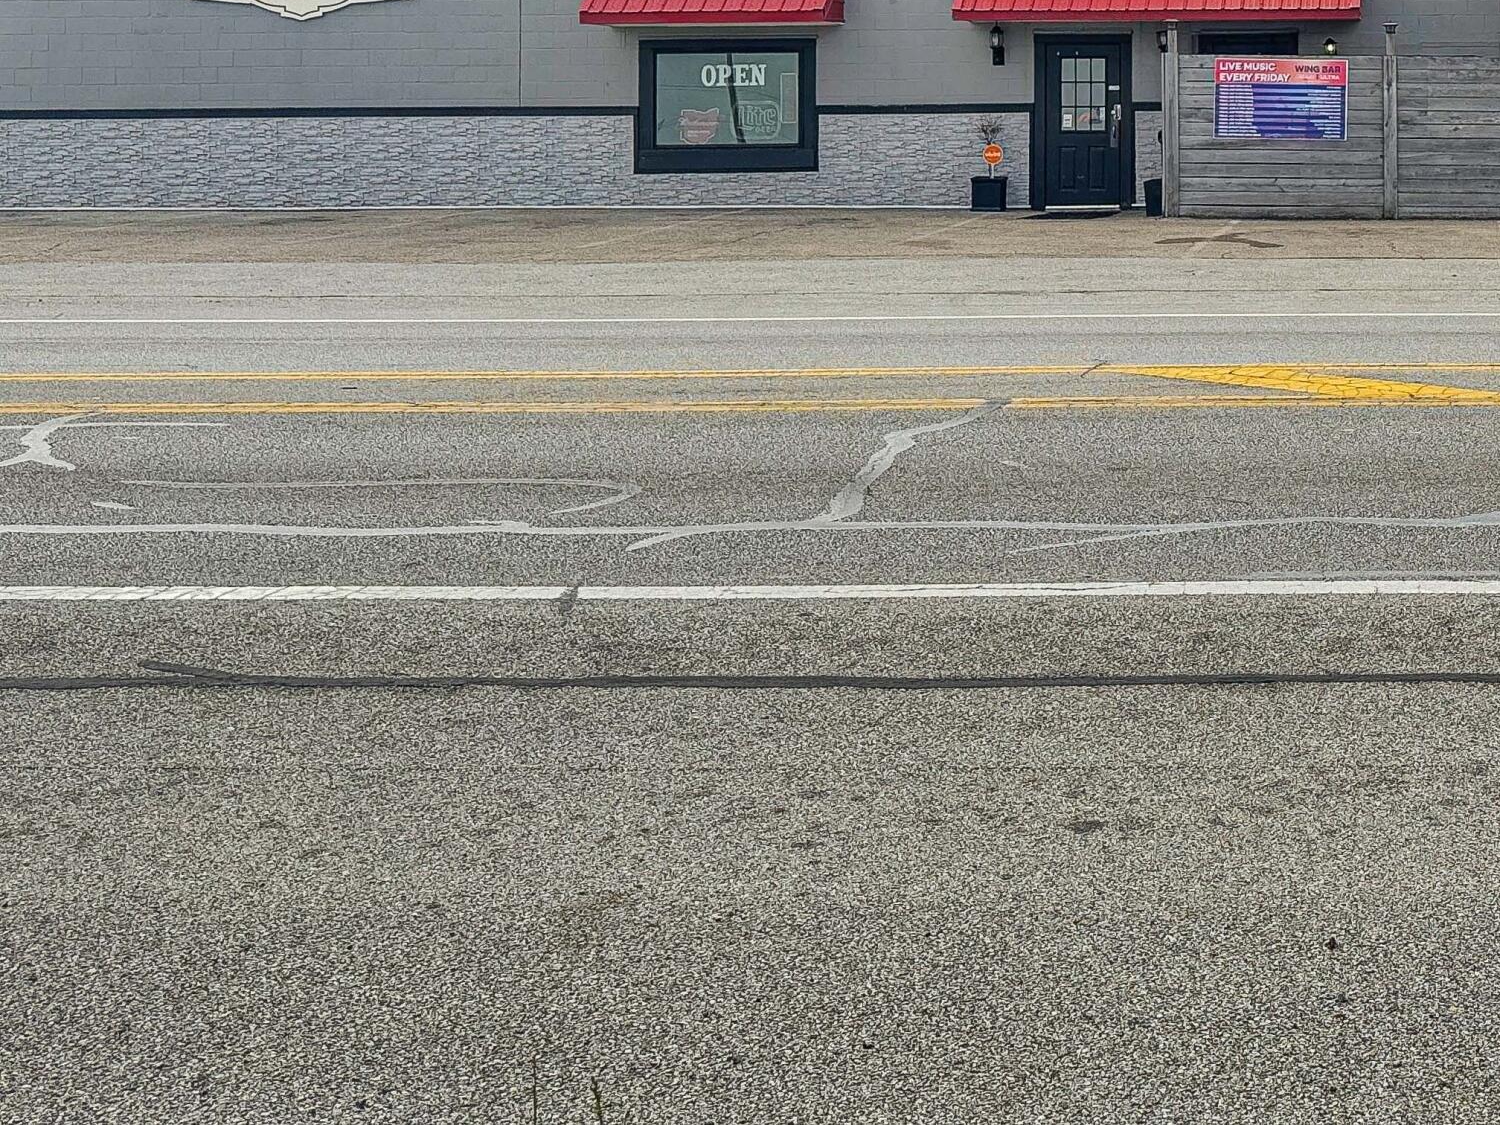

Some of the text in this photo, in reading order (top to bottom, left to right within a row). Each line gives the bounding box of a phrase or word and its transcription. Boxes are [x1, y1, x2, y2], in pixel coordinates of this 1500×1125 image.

[1220, 62, 1276, 71] LIVE MUSIC
[1295, 65, 1341, 73] WING BAR
[701, 64, 767, 87] OPEN
[1219, 72, 1253, 82] EVERY
[1254, 73, 1290, 83] FRIDAY
[738, 105, 777, 130] Lite
